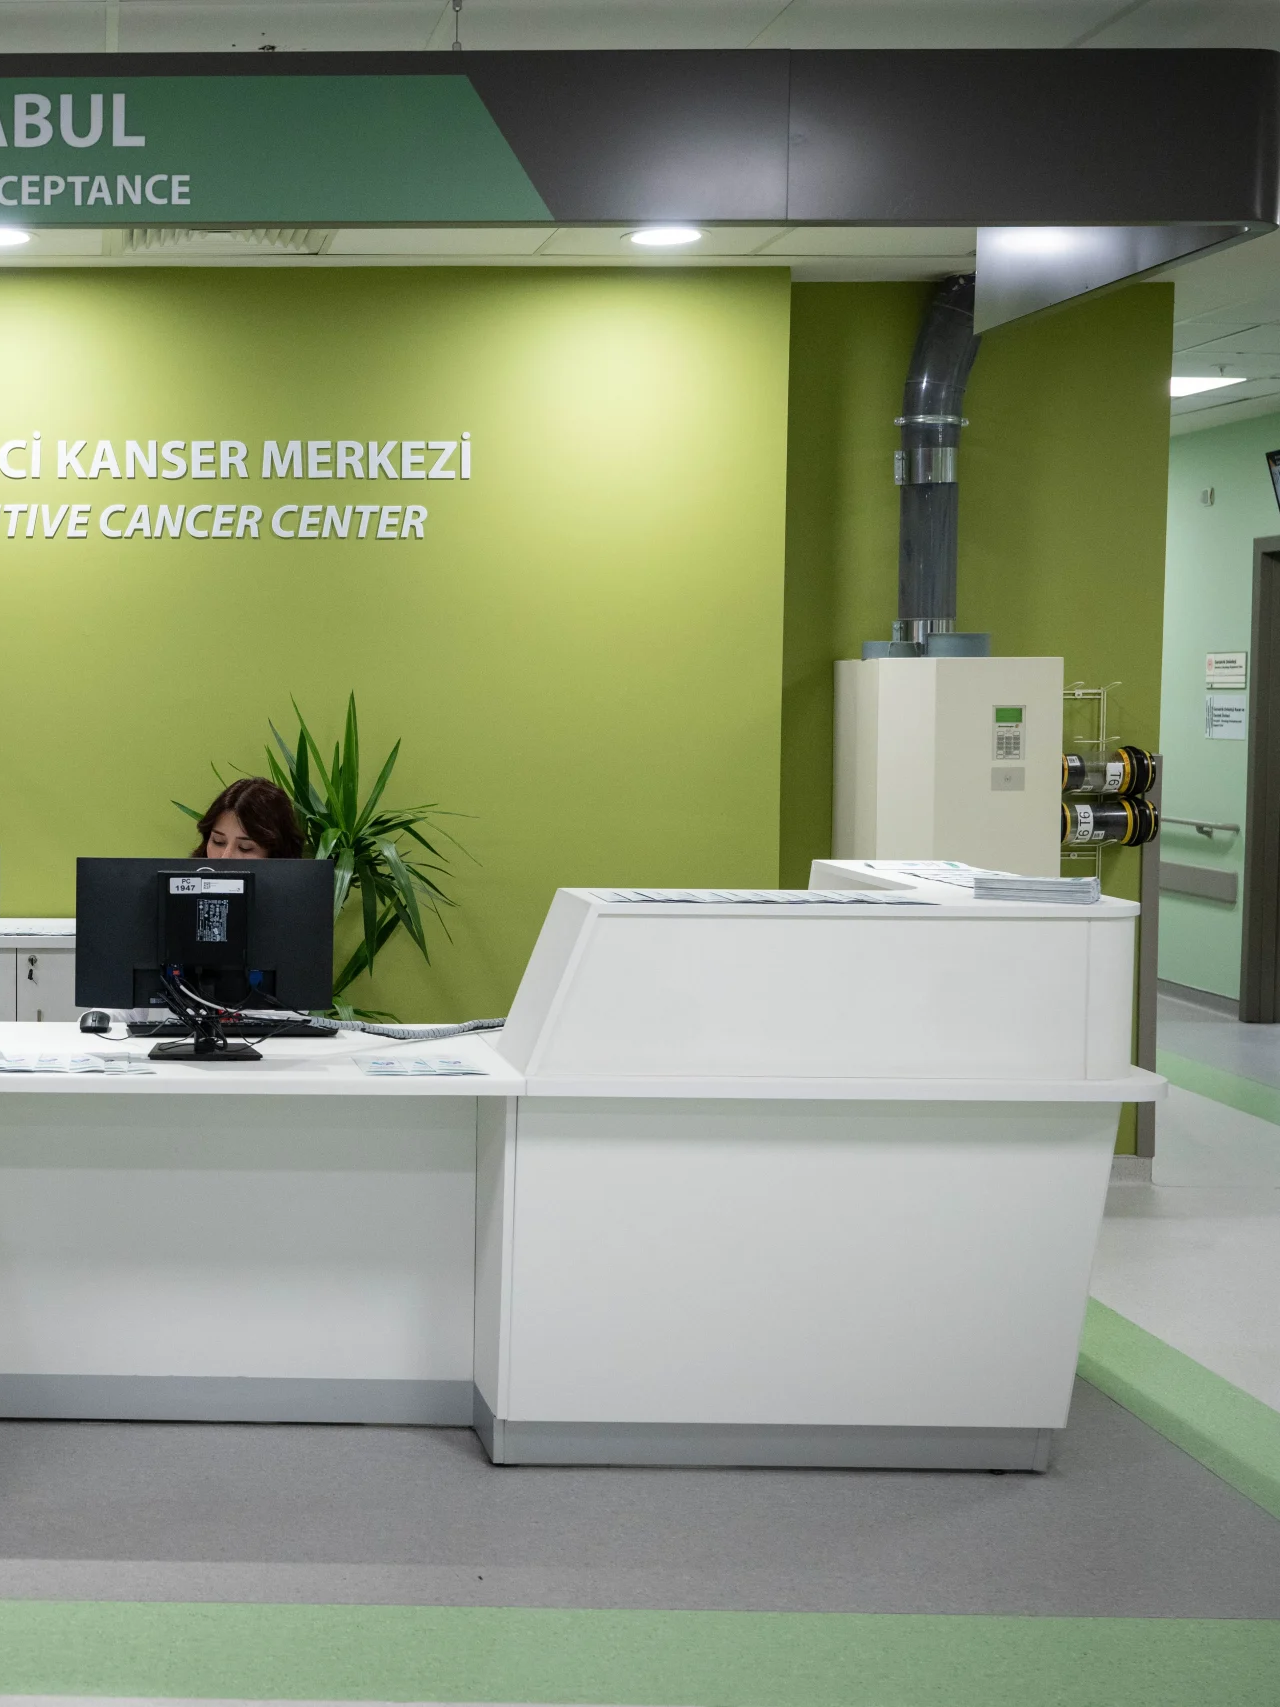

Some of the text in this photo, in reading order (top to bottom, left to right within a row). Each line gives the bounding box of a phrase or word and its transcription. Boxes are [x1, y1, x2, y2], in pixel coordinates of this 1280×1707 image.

[57, 440, 250, 480] KANSER
[262, 431, 472, 480] MERKEZİ
[99, 504, 263, 539] CANCER
[272, 504, 428, 539] CENTER
